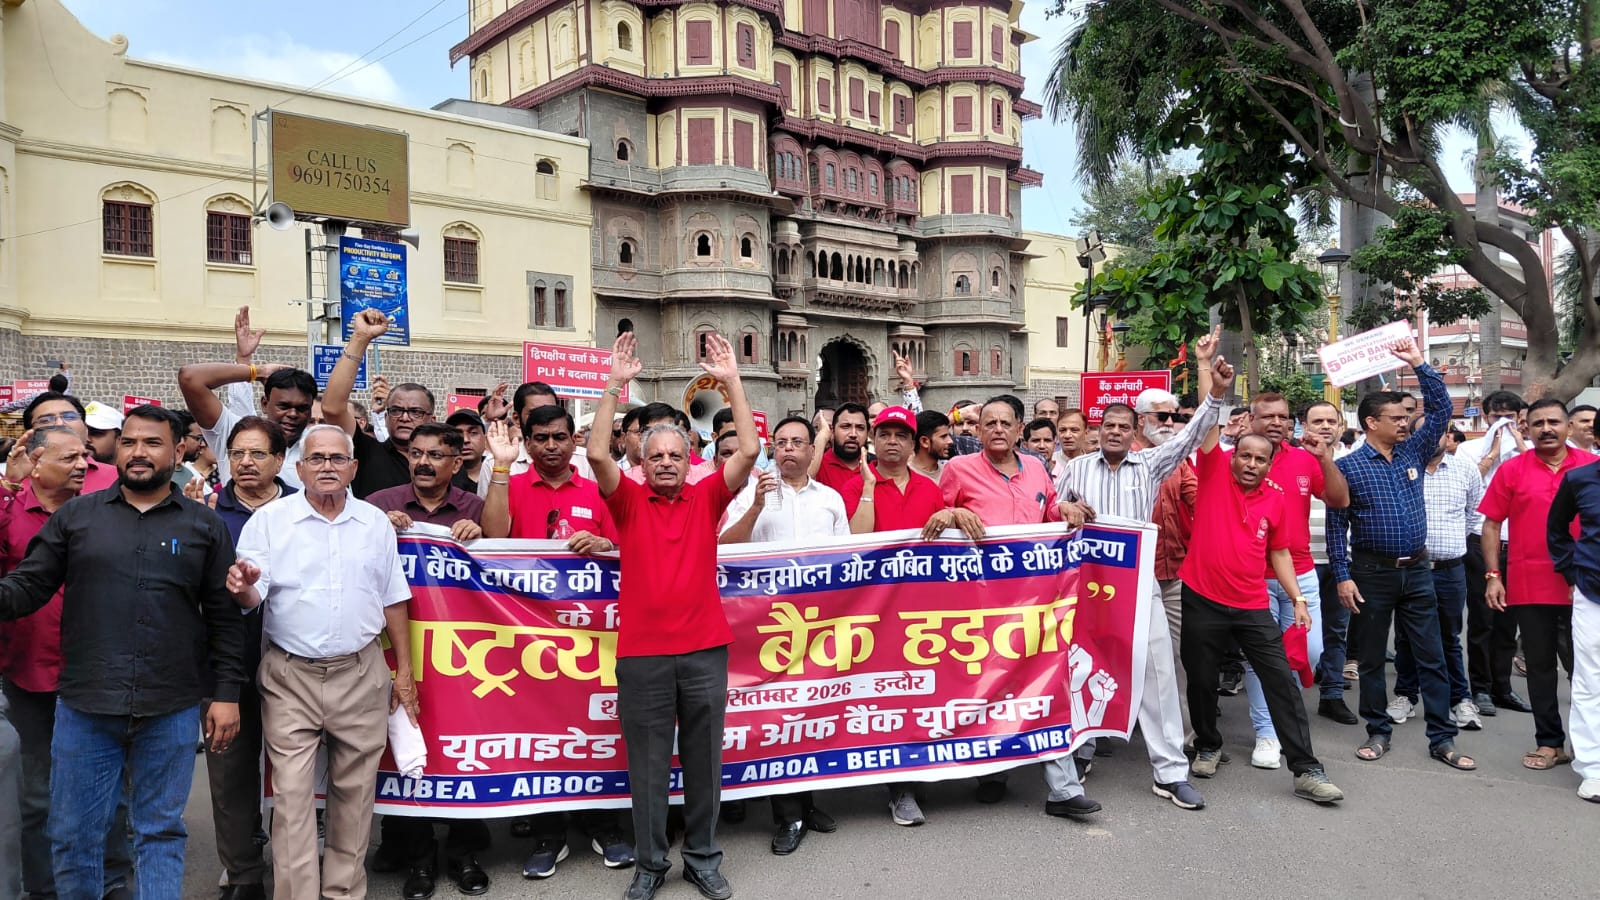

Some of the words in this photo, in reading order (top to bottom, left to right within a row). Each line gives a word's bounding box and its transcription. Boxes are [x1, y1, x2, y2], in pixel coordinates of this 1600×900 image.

[307, 150, 352, 170] CALL
[356, 157, 377, 174] US
[293, 165, 391, 196] 9691750354
[343, 246, 380, 257] PRODUCTIVITY
[530, 347, 566, 361] द्विपक्षीय
[568, 352, 587, 364] चर्चा
[589, 353, 599, 364] के
[1326, 360, 1341, 372] 5
[1340, 350, 1366, 365] DAYS
[1368, 352, 1387, 363] PER
[537, 366, 555, 377] PLI
[557, 366, 566, 378] में
[567, 369, 598, 380] बदलाव
[1098, 380, 1112, 391] बैंक
[1114, 378, 1143, 391] कर्मचारी
[1096, 393, 1128, 405] अधिकारी
[426, 546, 471, 581] बैंक
[566, 561, 603, 593] की
[737, 558, 833, 595] अनुमोदन
[839, 552, 876, 583] और
[989, 544, 1014, 573] के
[1022, 542, 1063, 571] शीघ्र
[555, 602, 594, 627] के
[756, 601, 881, 675] बैंक
[726, 687, 799, 707] सितम्बर
[806, 682, 852, 702] 2026
[874, 671, 927, 694] इन्दौर
[438, 726, 622, 772] यूनाइटेड
[759, 712, 840, 747] ऑफ
[843, 704, 907, 735] बैंक
[912, 693, 1055, 739] यूनियंस
[380, 776, 476, 800] AIBEA
[511, 776, 604, 798] AIBOC
[741, 757, 819, 782] AIBOA
[847, 748, 901, 770] BEFI
[927, 739, 1002, 763] INBEF
